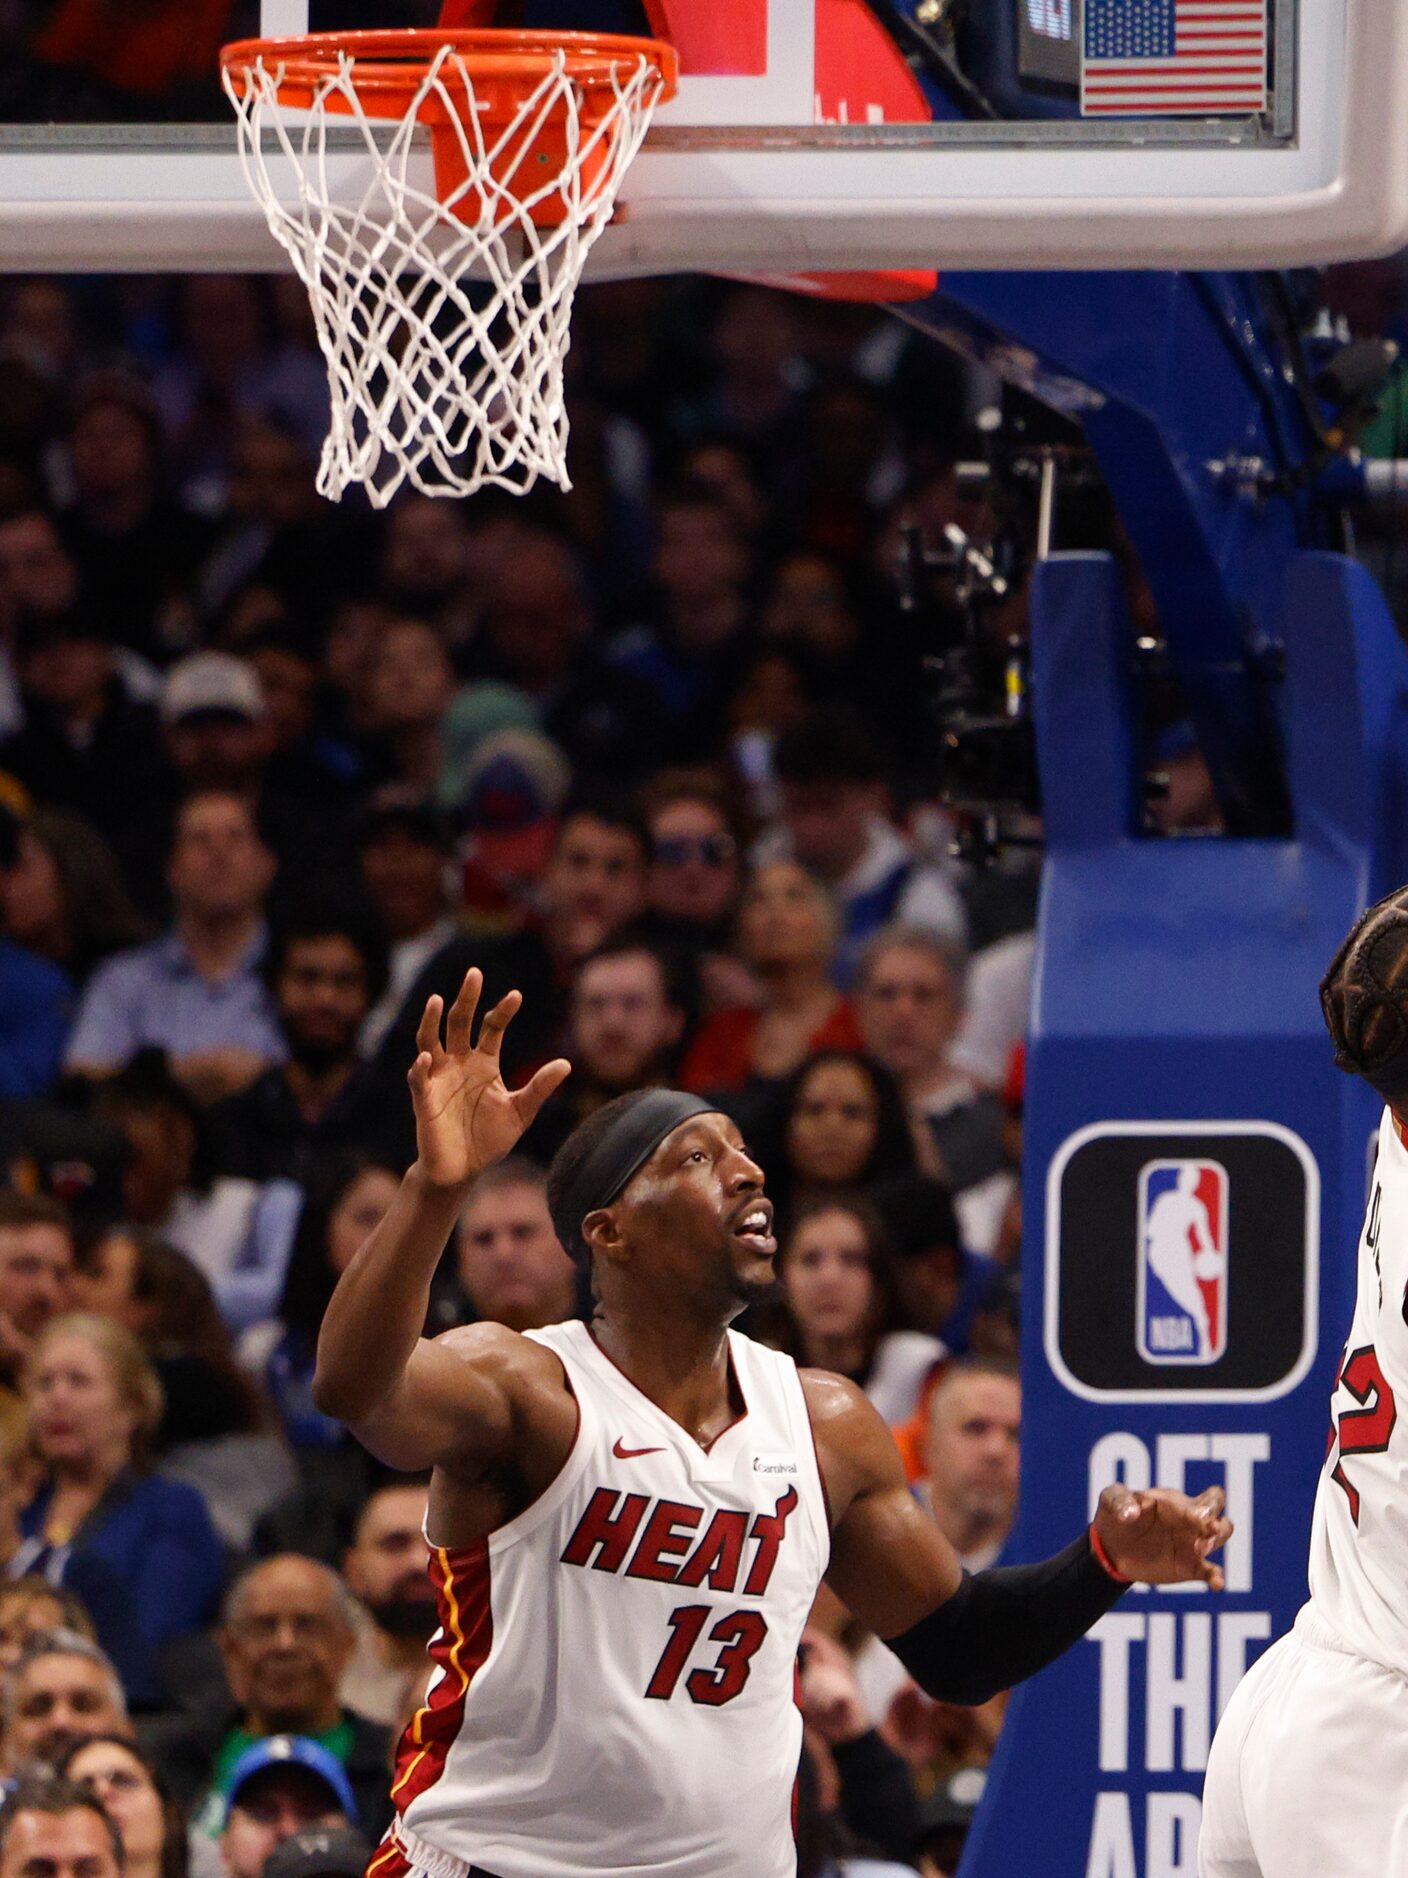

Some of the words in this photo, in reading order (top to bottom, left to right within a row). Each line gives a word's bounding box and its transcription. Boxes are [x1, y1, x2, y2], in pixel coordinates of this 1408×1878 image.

[758, 1463, 798, 1474] Carnival
[559, 1484, 799, 1597] HEAT
[644, 1604, 769, 1707] 13
